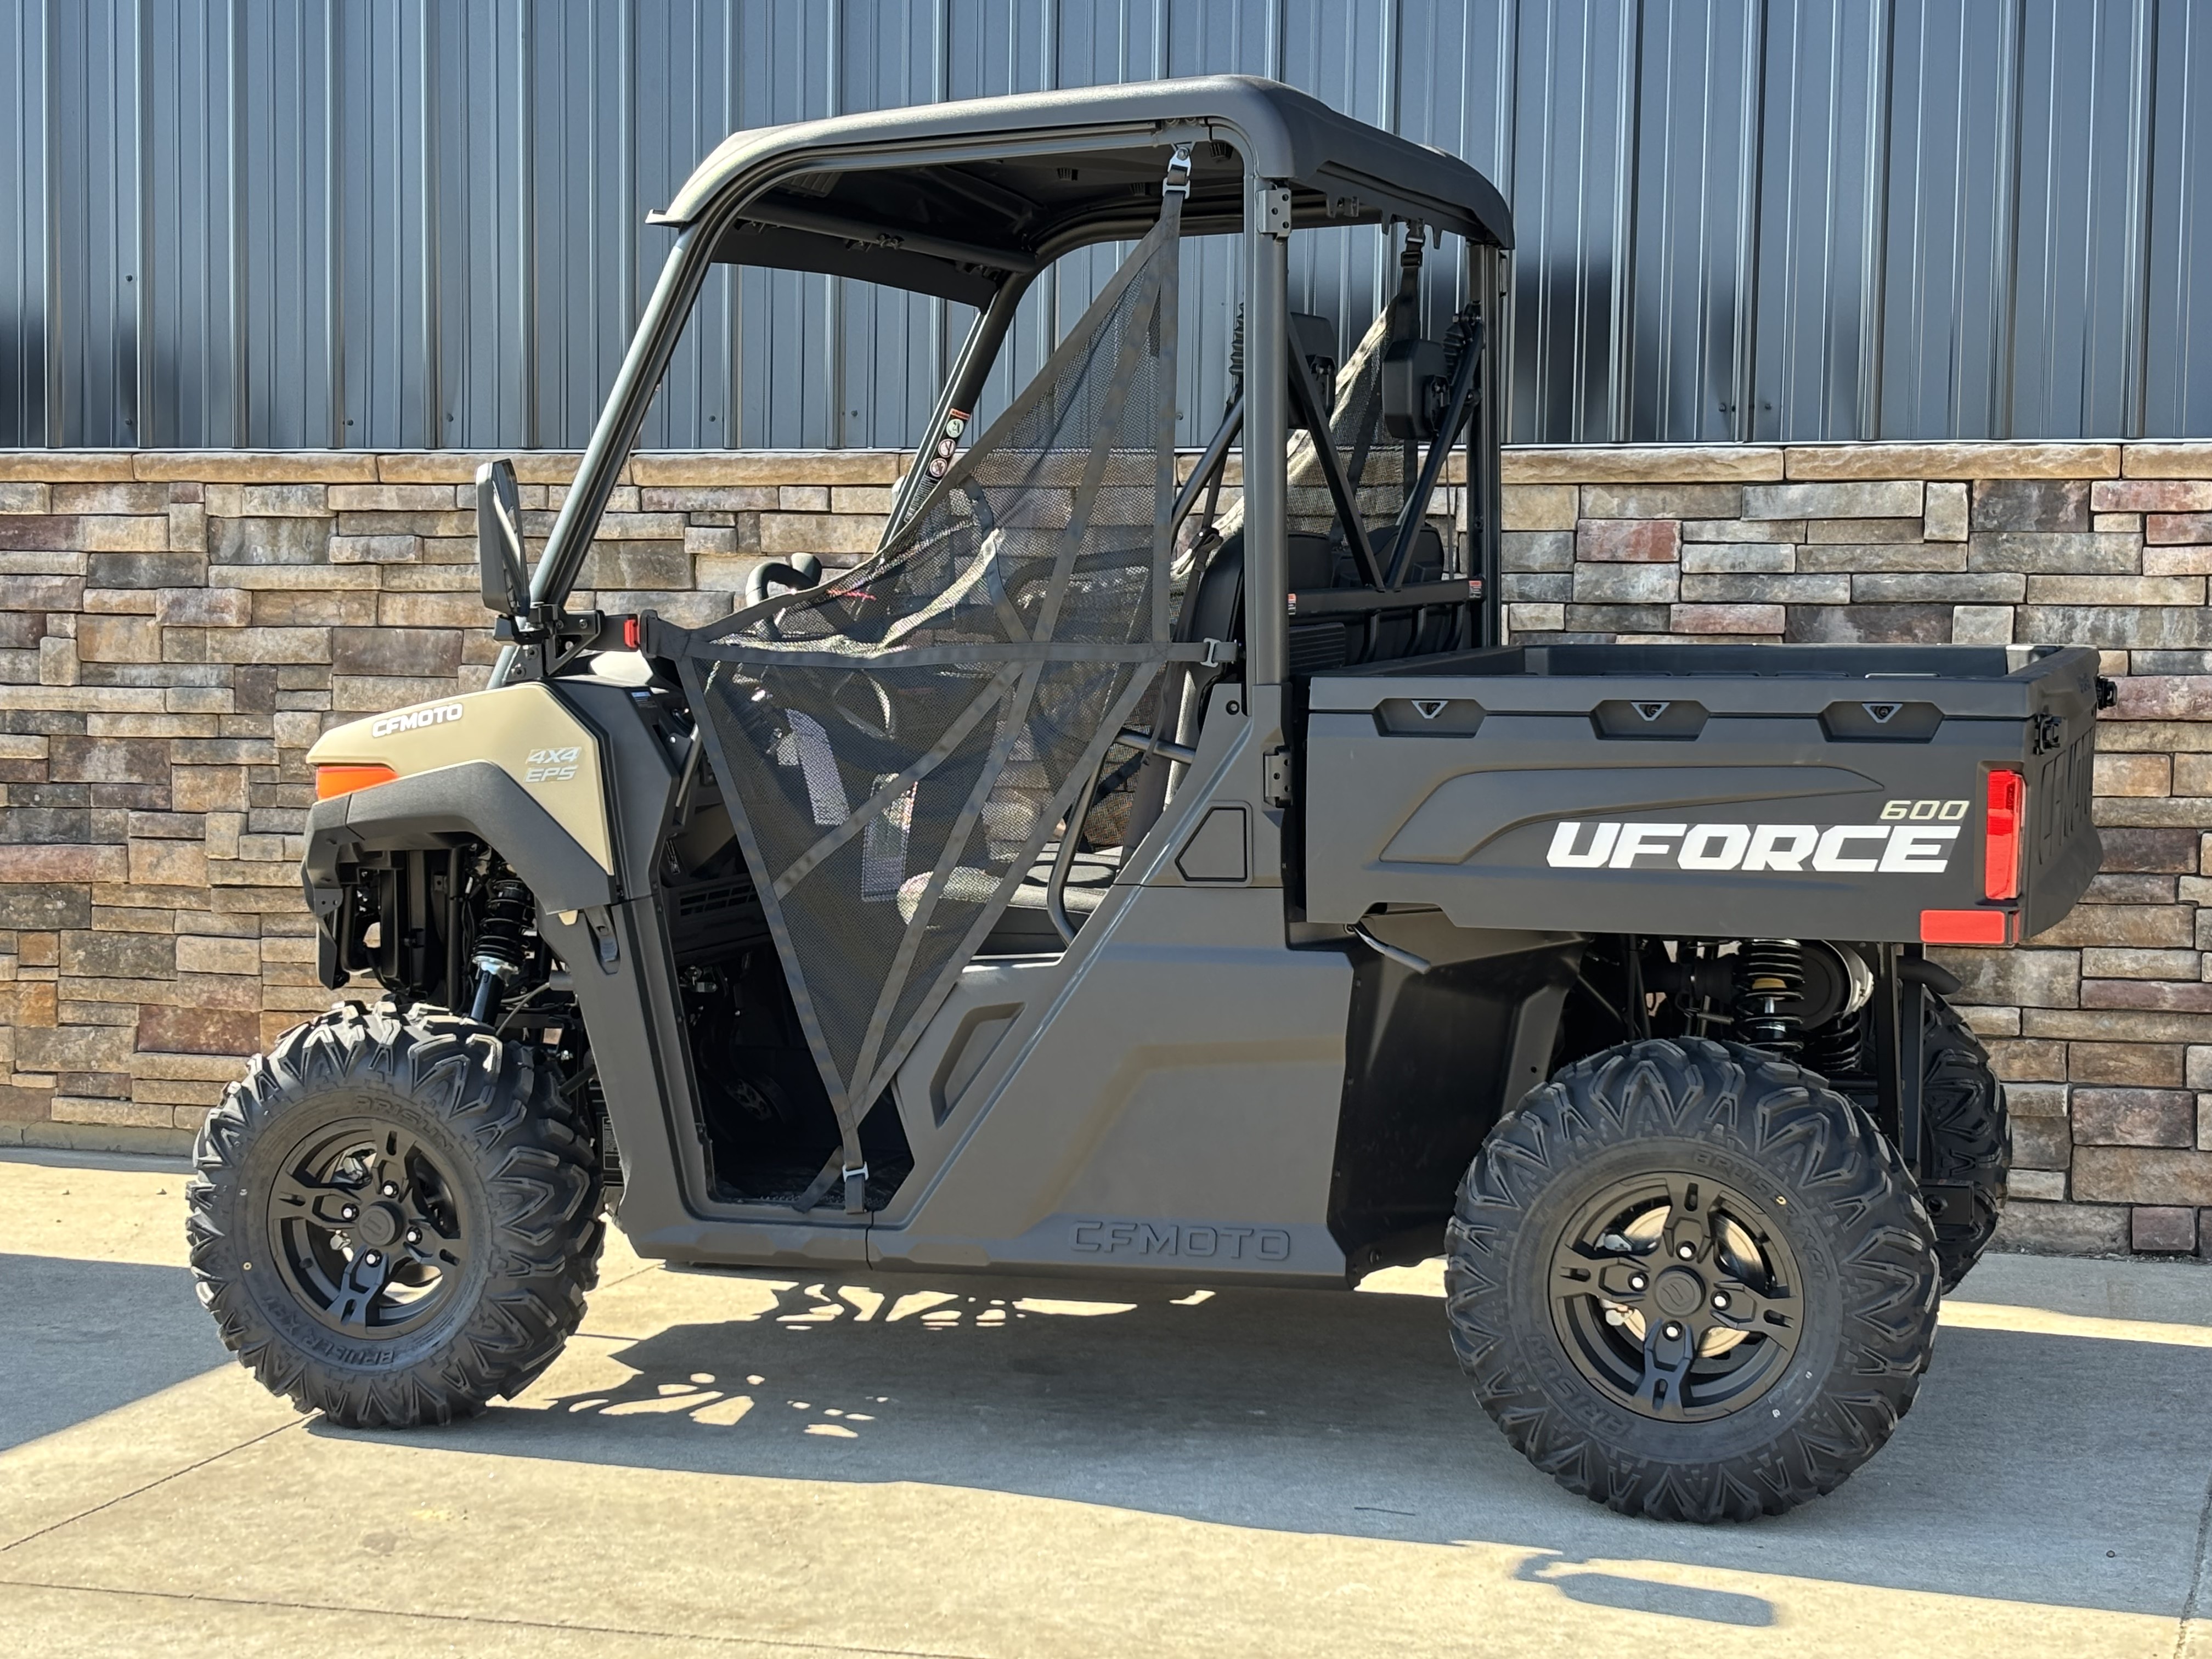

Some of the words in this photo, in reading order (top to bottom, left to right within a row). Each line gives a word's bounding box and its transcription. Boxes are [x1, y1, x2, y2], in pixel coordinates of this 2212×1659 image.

[372, 703, 462, 737] CFMOTO
[528, 747, 579, 764] 4X4
[525, 766, 577, 782] EPS
[1880, 800, 1970, 820] 600
[1547, 822, 1961, 873] UFORCE
[1069, 1221, 1291, 1261] CFMOTO
